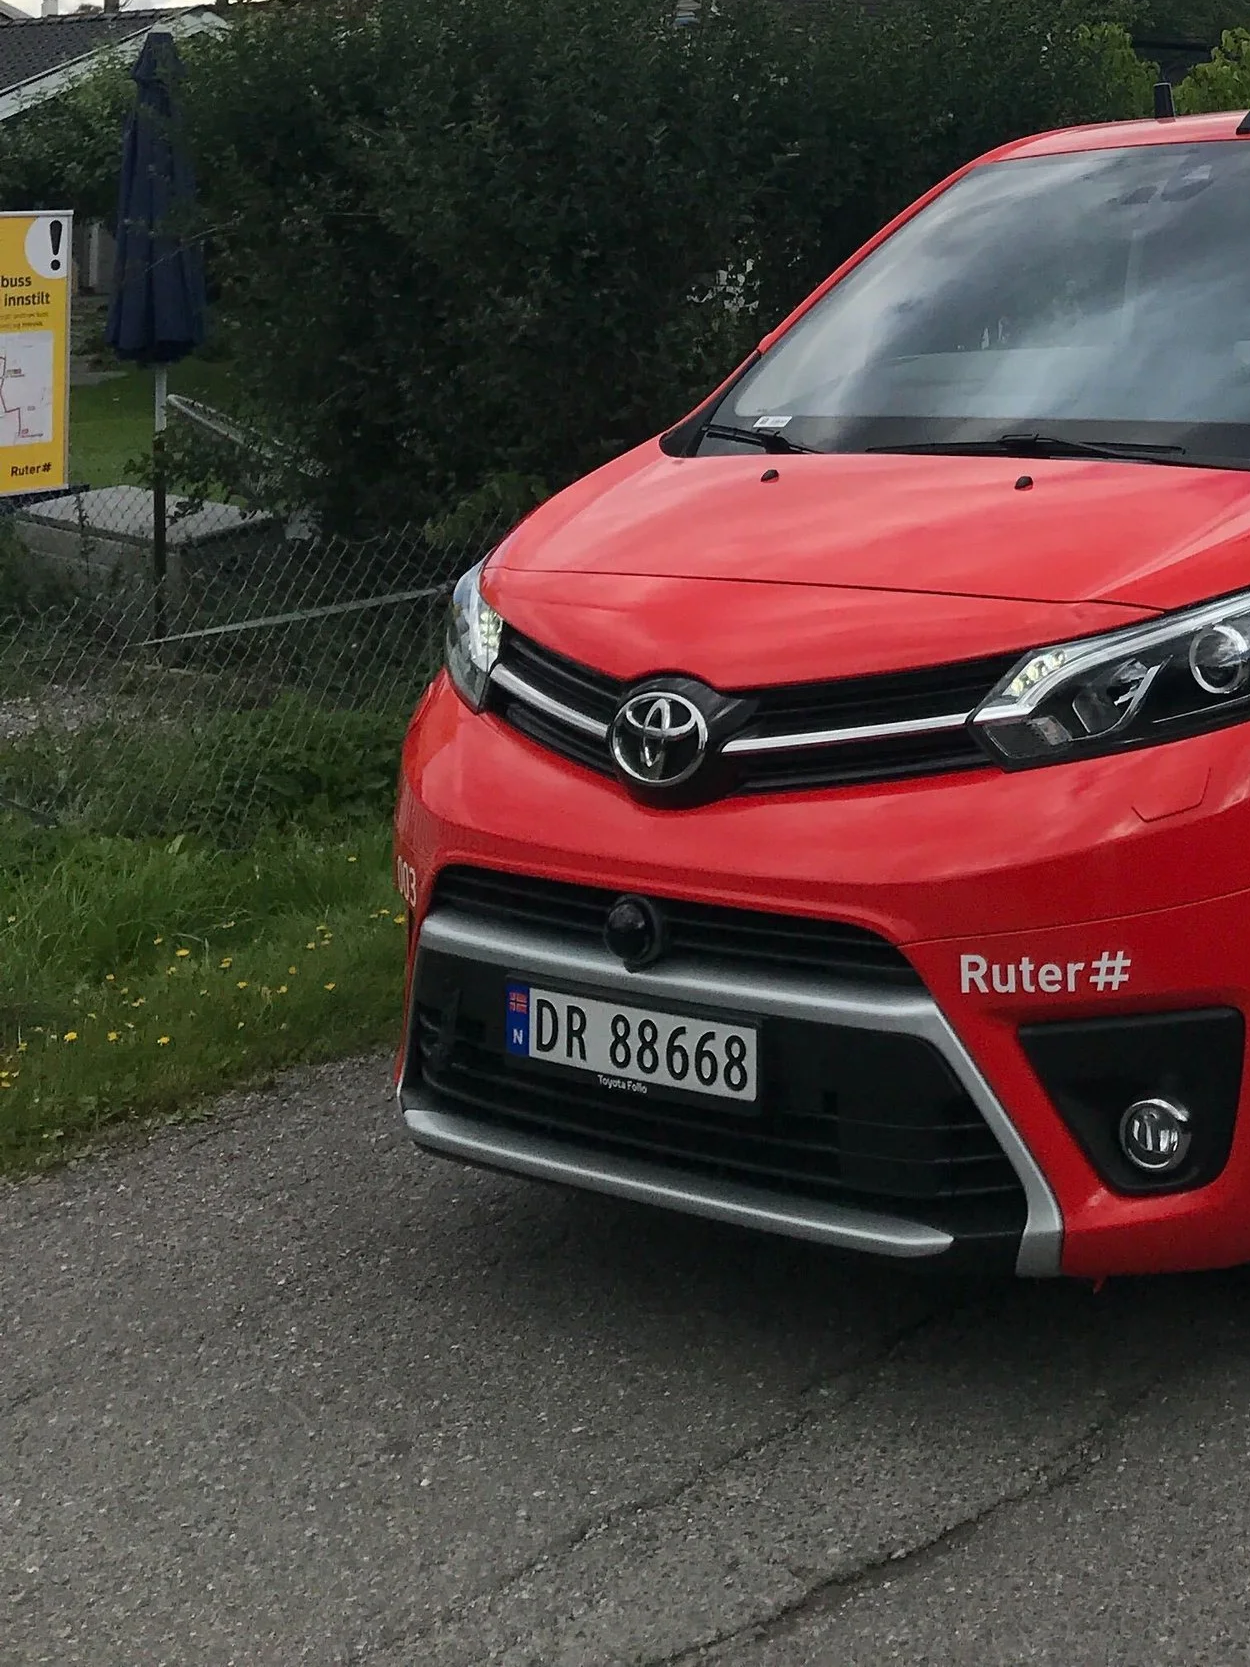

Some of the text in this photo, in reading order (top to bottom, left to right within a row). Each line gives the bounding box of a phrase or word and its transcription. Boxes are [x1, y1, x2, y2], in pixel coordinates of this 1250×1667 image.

[1, 275, 32, 288] buss
[4, 291, 50, 306] innstilt
[10, 462, 52, 477] Ruter#
[960, 950, 1131, 994] Ruter#
[513, 1028, 523, 1045] N
[536, 998, 748, 1092] DR 88668
[597, 1074, 627, 1089] Toyota
